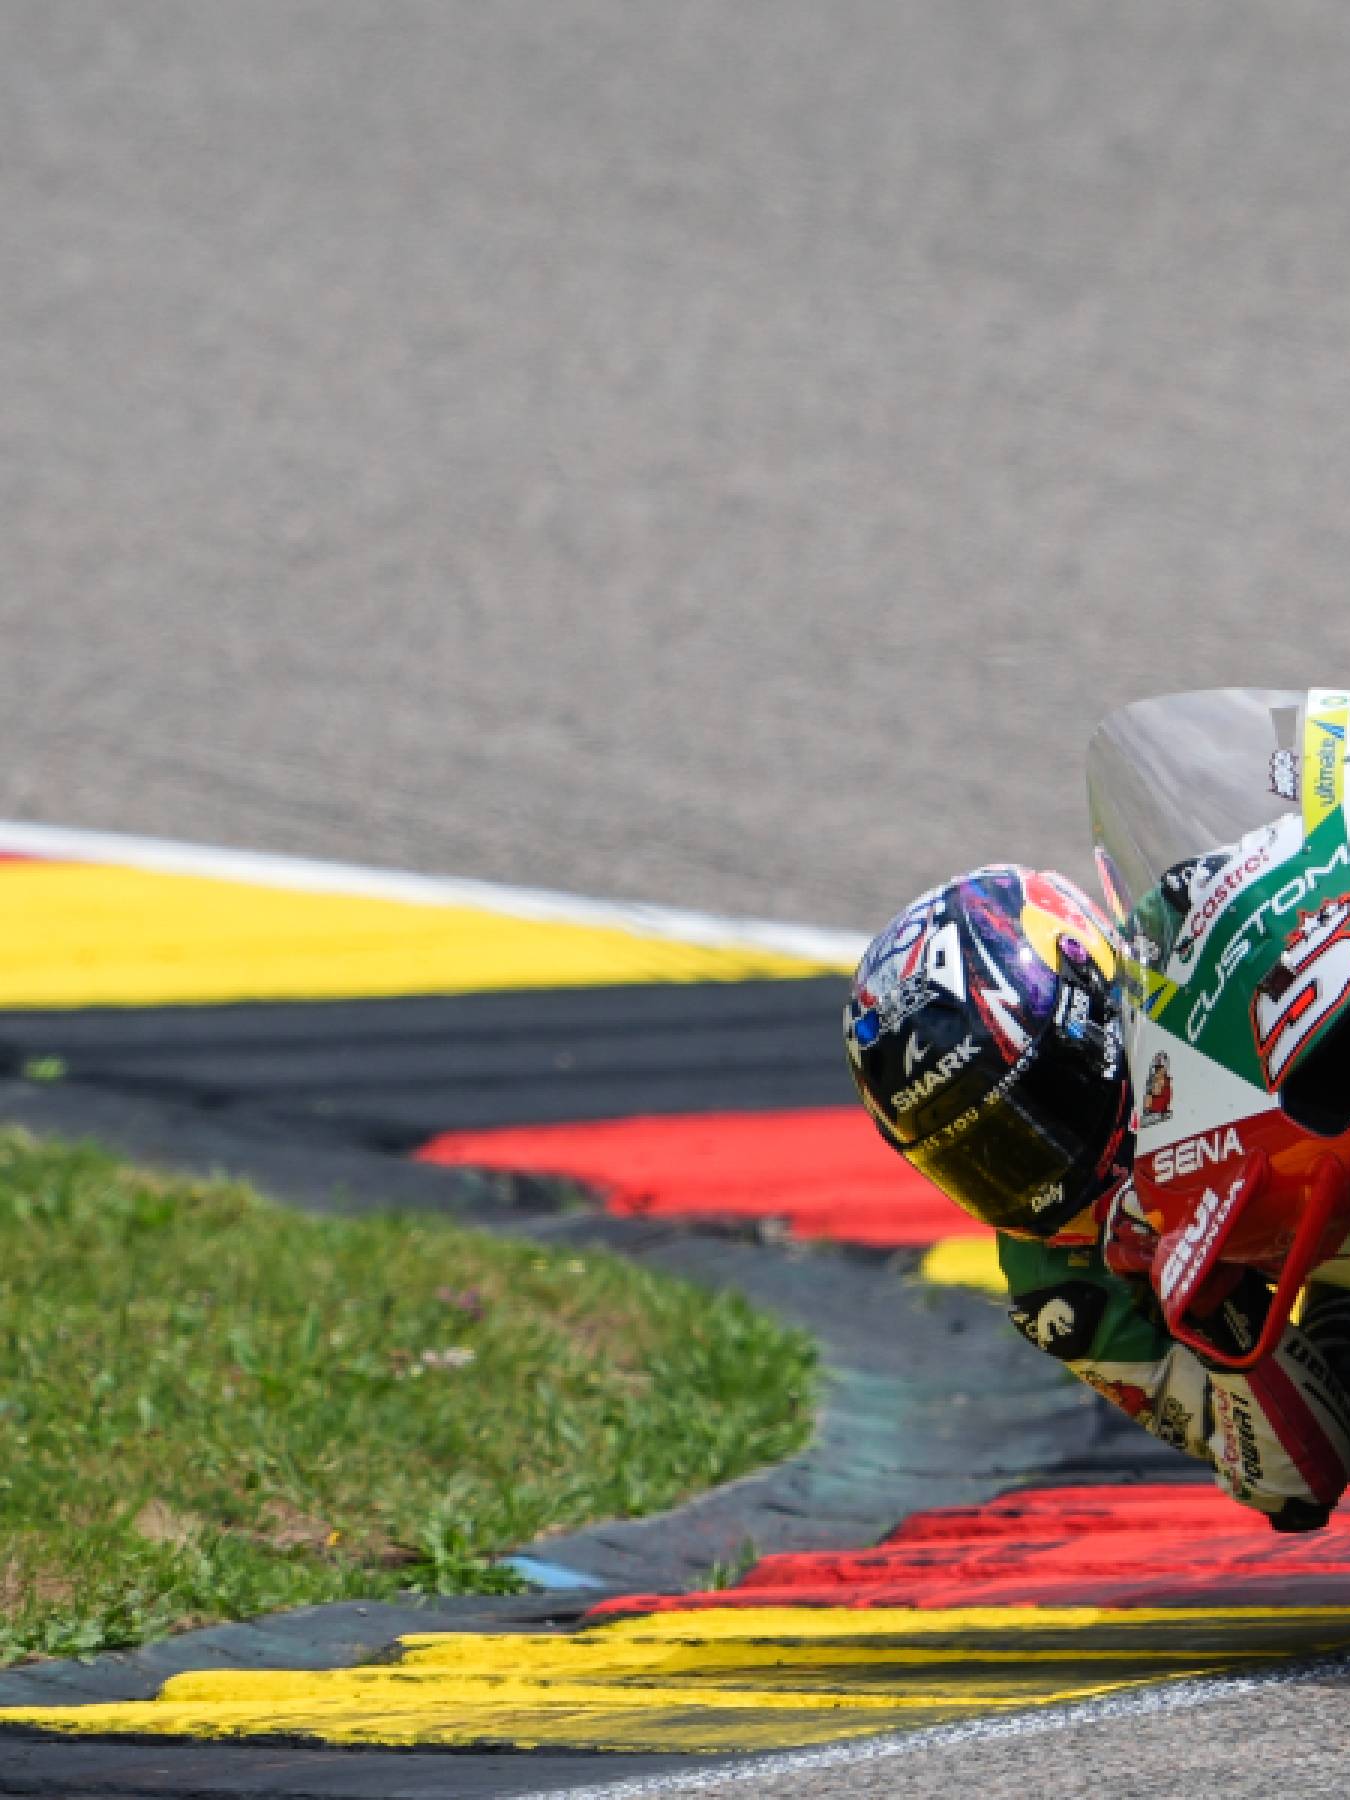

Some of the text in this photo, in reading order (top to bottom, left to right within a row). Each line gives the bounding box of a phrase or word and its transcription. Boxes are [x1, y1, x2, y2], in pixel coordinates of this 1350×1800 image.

[890, 1034, 982, 1112] SHARK
[1152, 1128, 1244, 1184] SENA
[1160, 1187, 1220, 1300] GIVI
[1176, 1178, 1246, 1298] HONDA
